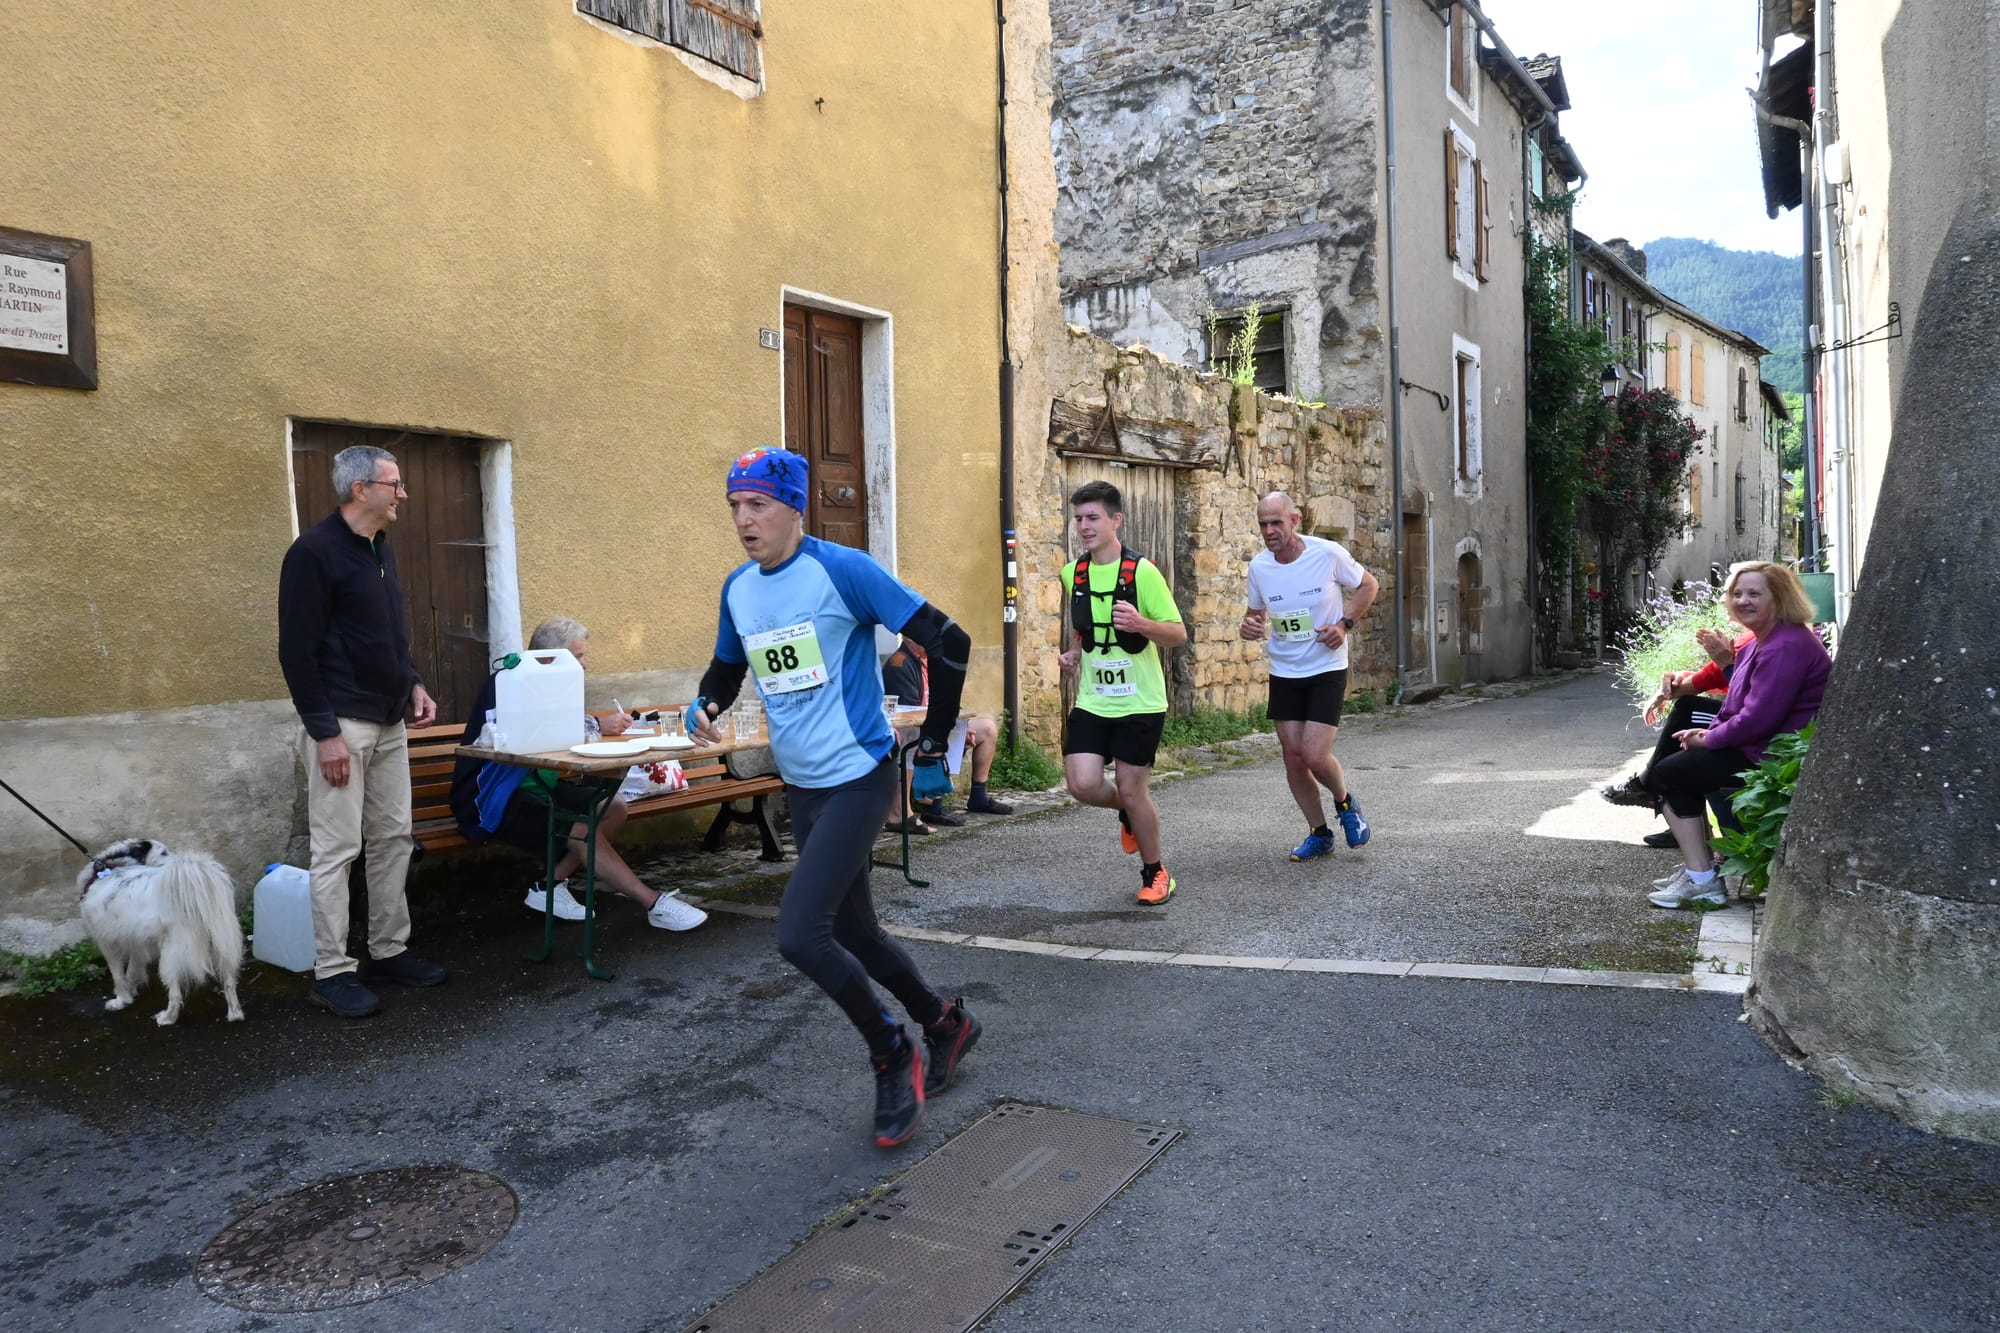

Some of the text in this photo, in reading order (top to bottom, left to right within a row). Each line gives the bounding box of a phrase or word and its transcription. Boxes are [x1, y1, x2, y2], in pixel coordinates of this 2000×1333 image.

[4, 265, 27, 278] Rue
[8, 282, 62, 300] Raymond
[11, 327, 25, 337] du
[28, 328, 62, 341] Pontet
[768, 333, 773, 346] 1
[1280, 618, 1301, 633] 15
[764, 644, 799, 674] 88
[1095, 668, 1126, 685] 101
